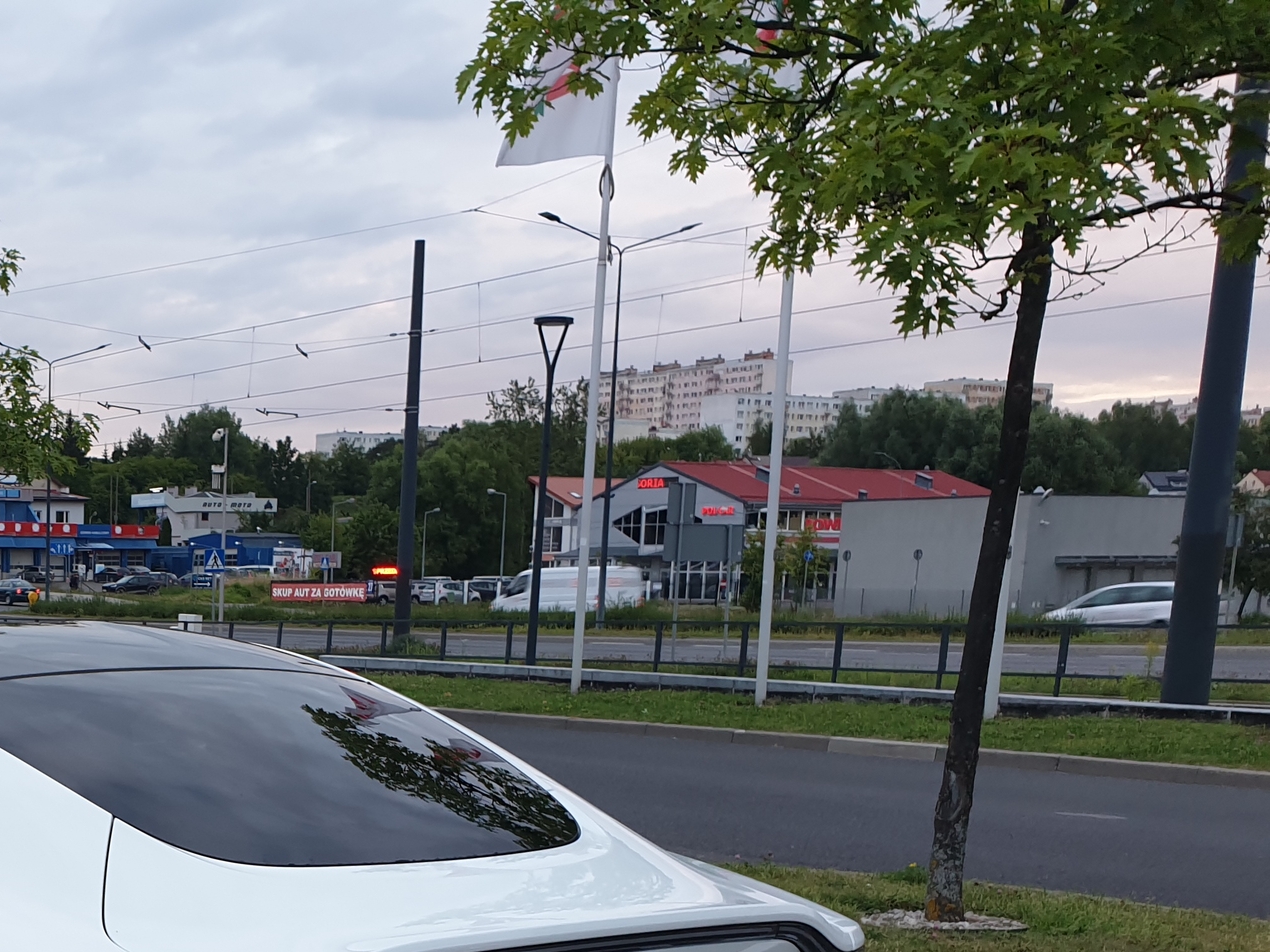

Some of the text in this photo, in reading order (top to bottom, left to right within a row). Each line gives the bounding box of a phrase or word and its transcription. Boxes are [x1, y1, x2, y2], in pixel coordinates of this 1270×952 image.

[272, 585, 365, 600] SKUP AUT ZA GOTÓWKĘ
